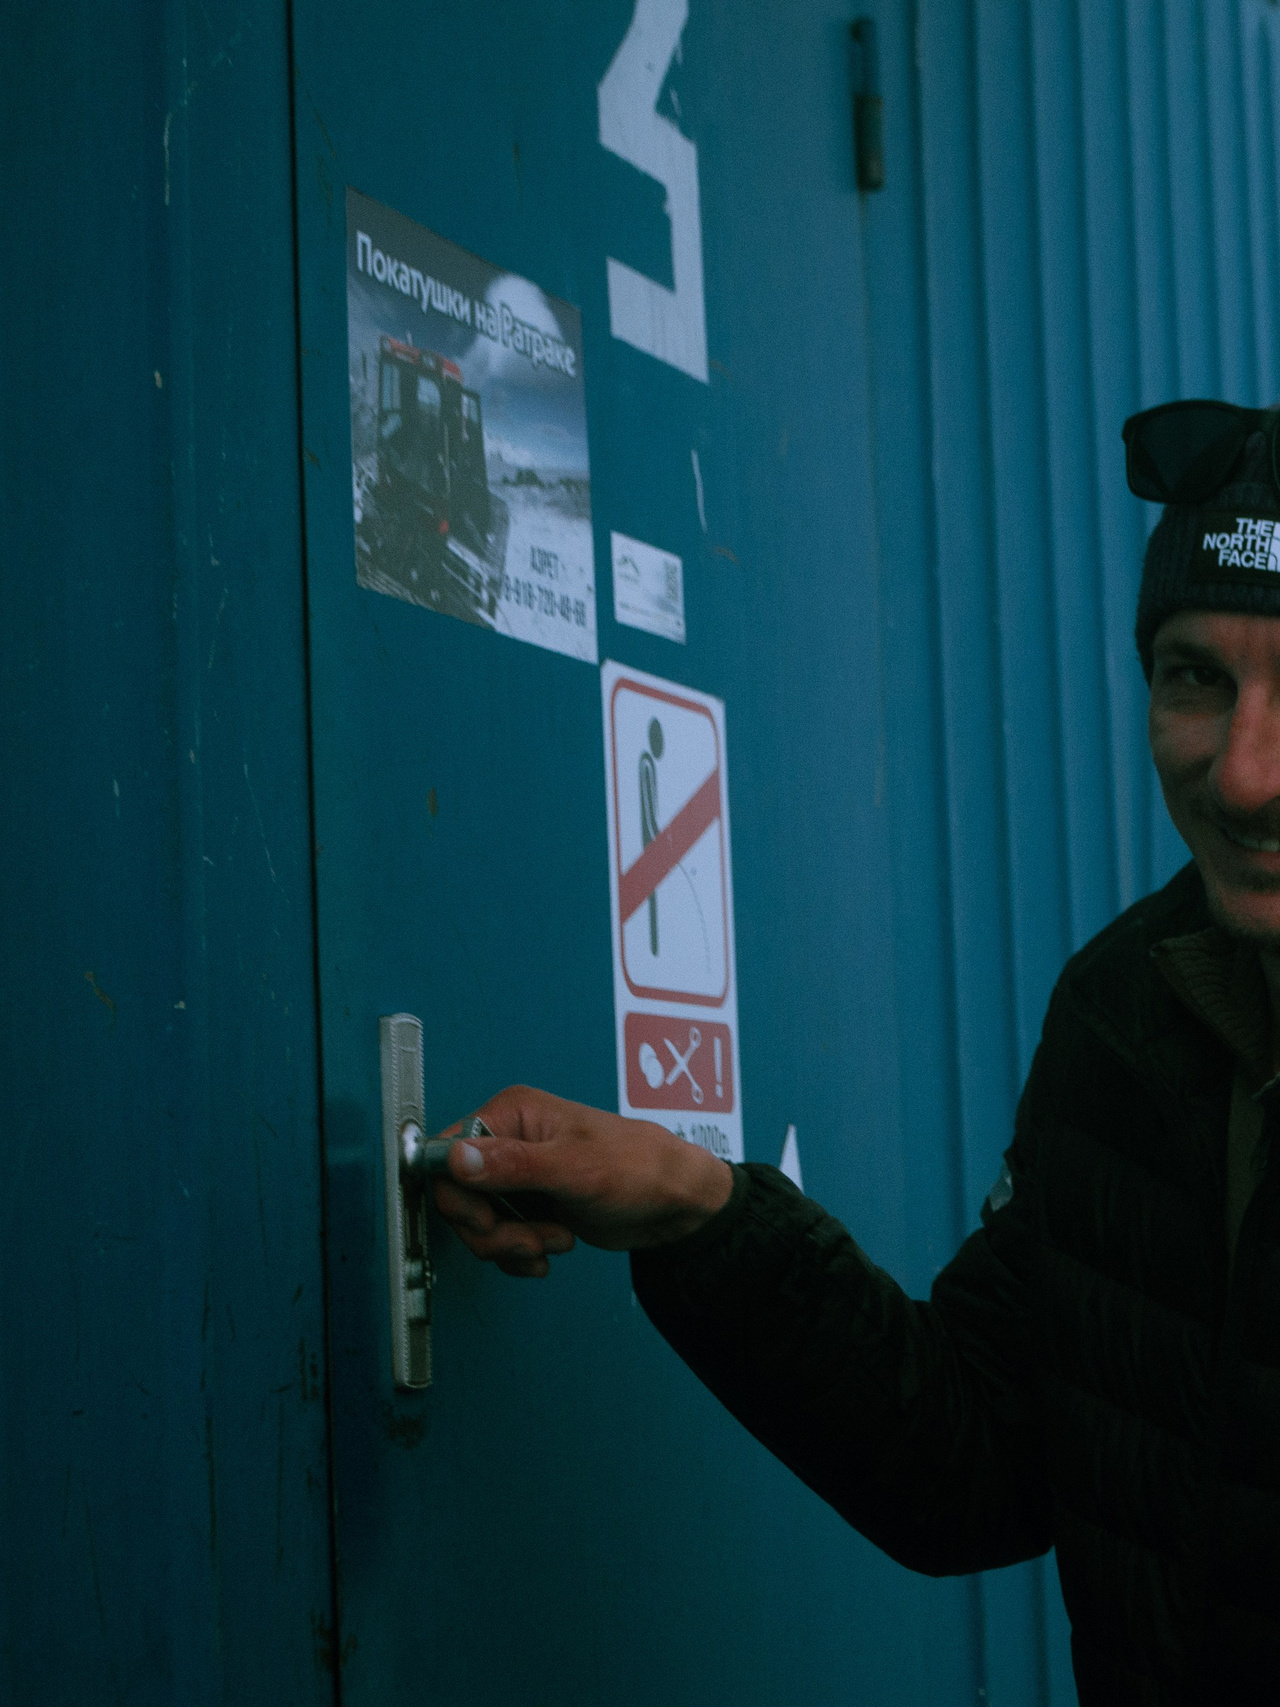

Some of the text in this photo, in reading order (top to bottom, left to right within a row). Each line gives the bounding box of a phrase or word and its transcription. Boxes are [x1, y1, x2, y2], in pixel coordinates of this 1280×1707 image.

[356, 229, 576, 378] Покатушки на Ратраке
[1236, 517, 1274, 537] THE
[1202, 531, 1271, 553] NORTH
[1218, 548, 1268, 570] FACE
